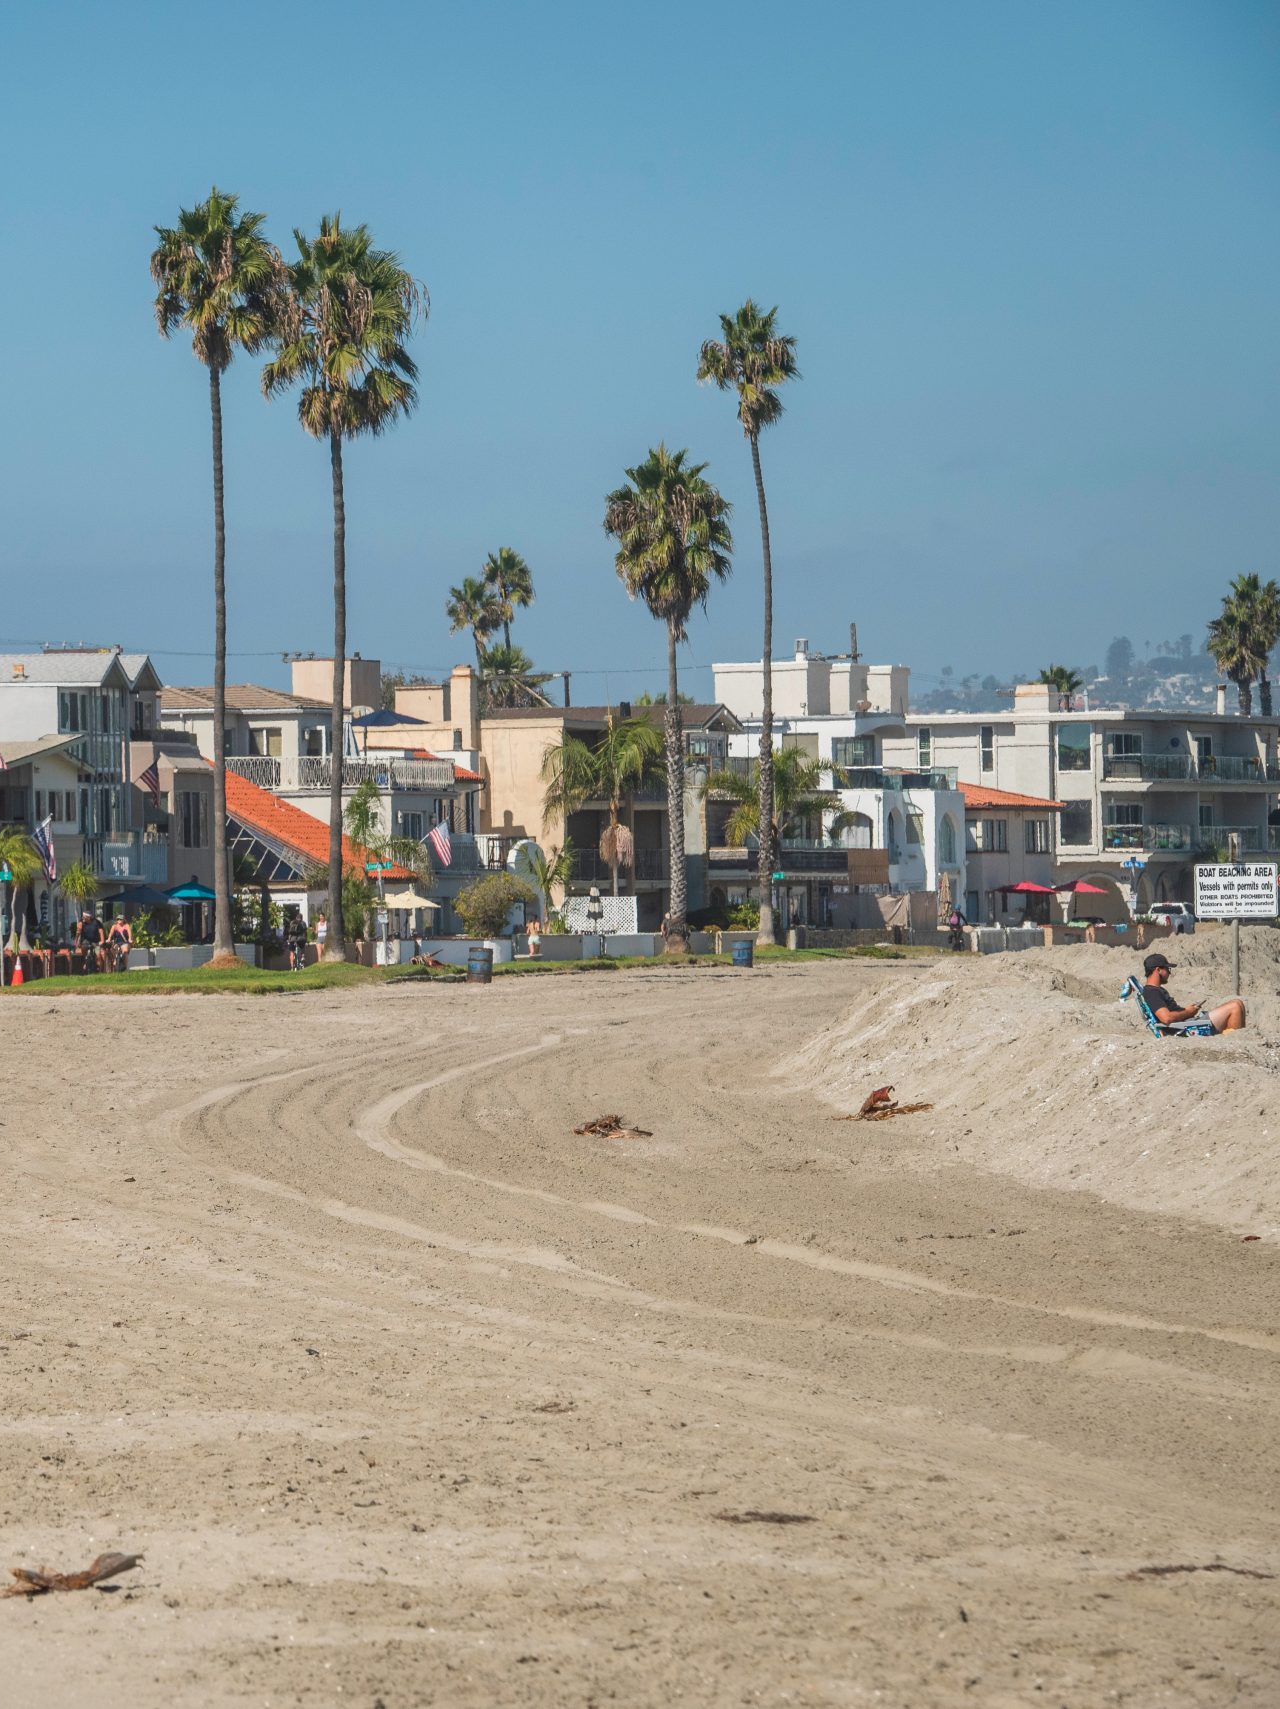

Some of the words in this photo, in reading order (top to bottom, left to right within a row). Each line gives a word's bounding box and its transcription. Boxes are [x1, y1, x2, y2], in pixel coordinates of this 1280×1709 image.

[1198, 867, 1216, 878] BOAT
[1218, 867, 1252, 877] BEACHING
[1254, 867, 1273, 877] AREA
[1199, 881, 1221, 891] Vessels
[1223, 881, 1235, 891] with
[1237, 881, 1259, 892] permits
[1261, 881, 1273, 892] only
